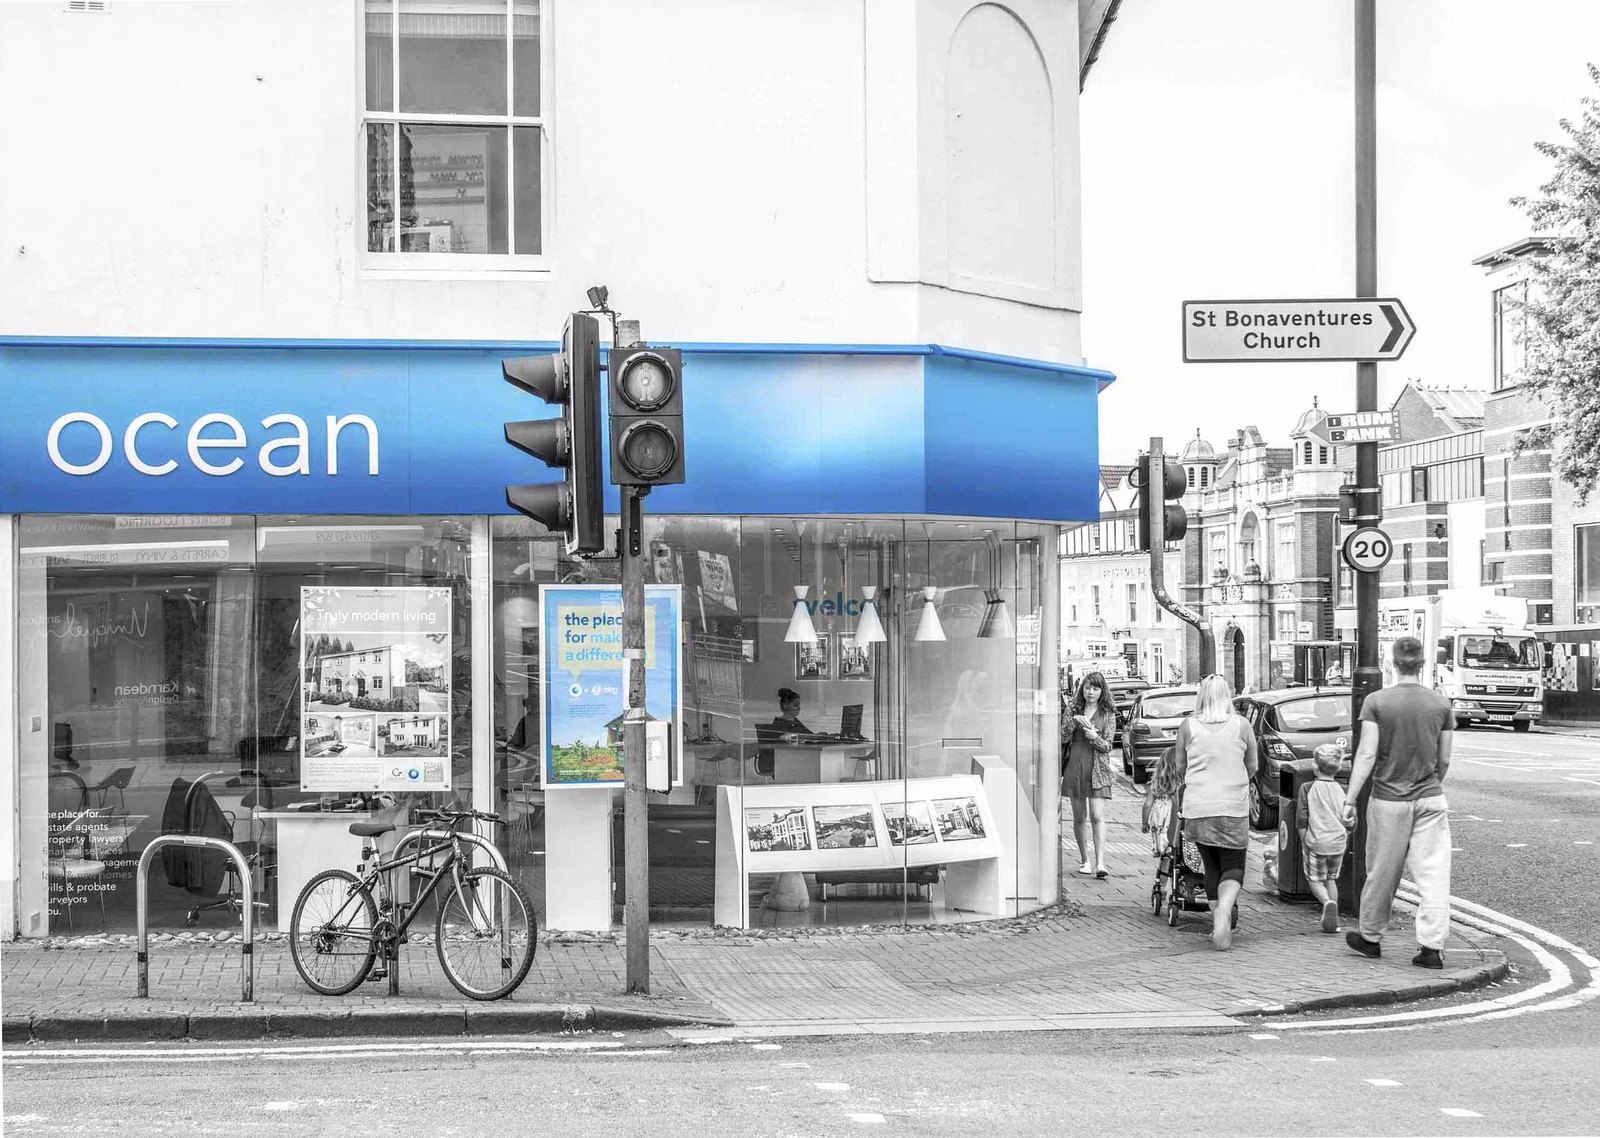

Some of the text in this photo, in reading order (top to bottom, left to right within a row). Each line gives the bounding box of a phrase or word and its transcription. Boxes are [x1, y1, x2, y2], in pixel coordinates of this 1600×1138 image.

[1192, 308, 1373, 328] St Bonaventures
[1243, 332, 1321, 349] Church
[1326, 411, 1393, 429] DRUM
[1329, 426, 1393, 443] BANK
[47, 411, 379, 476] ocean
[1354, 540, 1387, 558] 20
[318, 609, 436, 624] Truly modern living
[565, 612, 622, 629] the plac
[565, 630, 587, 643] for
[565, 651, 574, 661] a
[58, 809, 84, 821] place
[48, 823, 109, 834] state agents
[48, 834, 124, 845] roperty lawyers
[48, 882, 117, 894] ills & probate
[48, 895, 88, 906] urveyors
